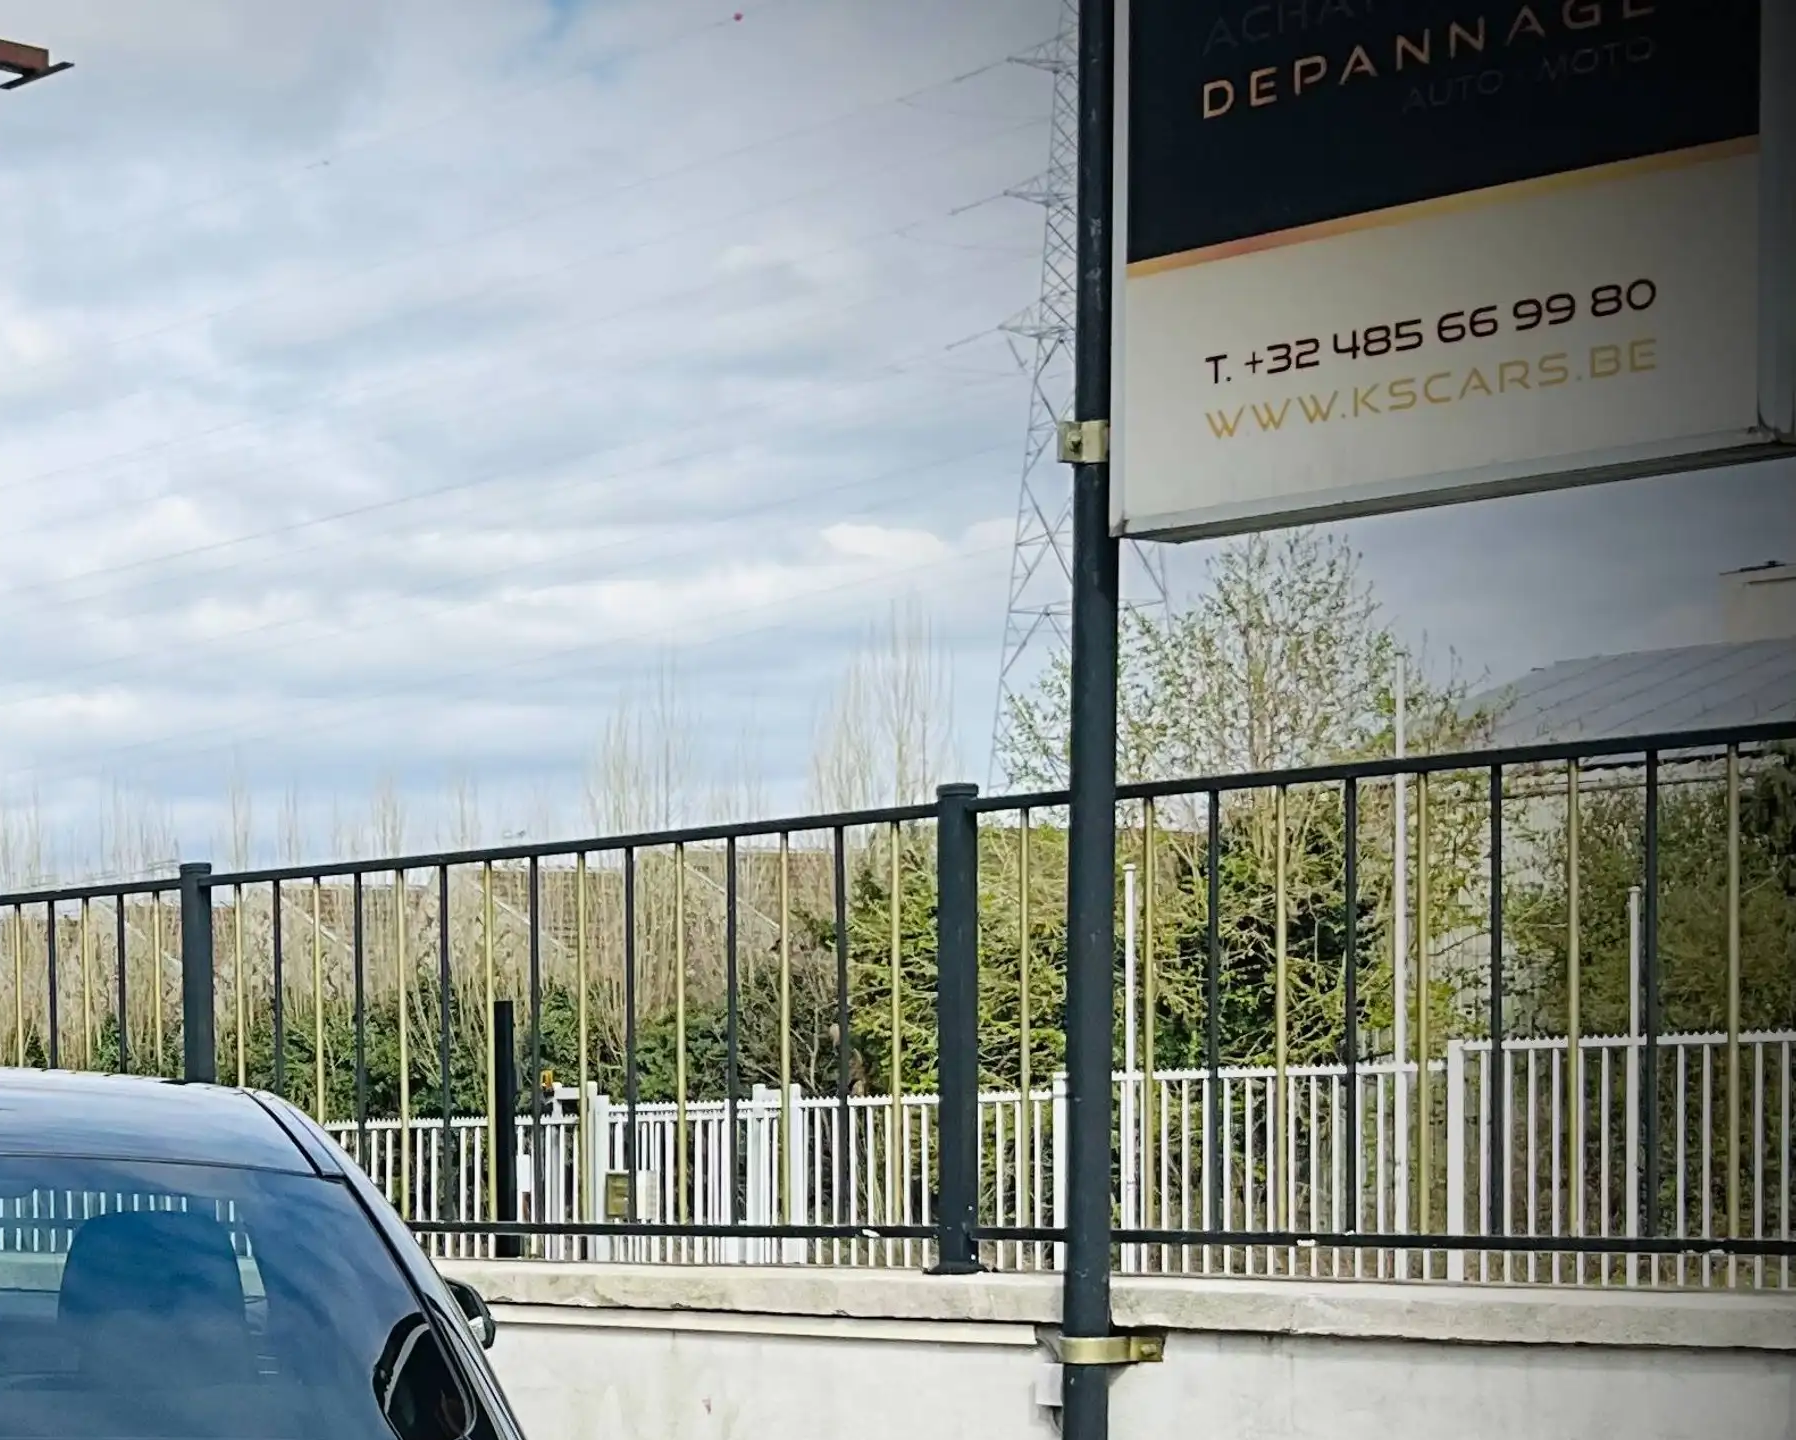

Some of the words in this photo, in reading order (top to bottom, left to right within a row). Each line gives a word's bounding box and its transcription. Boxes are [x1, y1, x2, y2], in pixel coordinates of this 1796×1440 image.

[1202, 0, 1374, 56] ACHA
[1402, 69, 1504, 115] AUTO
[1534, 35, 1656, 82] MOTO
[1205, 354, 1232, 384] T.
[1244, 338, 1320, 375] +32
[1332, 318, 1423, 360] 485
[1436, 305, 1498, 343] 66
[1512, 293, 1576, 331] 99
[1590, 278, 1657, 317] 80
[1205, 338, 1657, 439] WWW.KSCARS.BE
